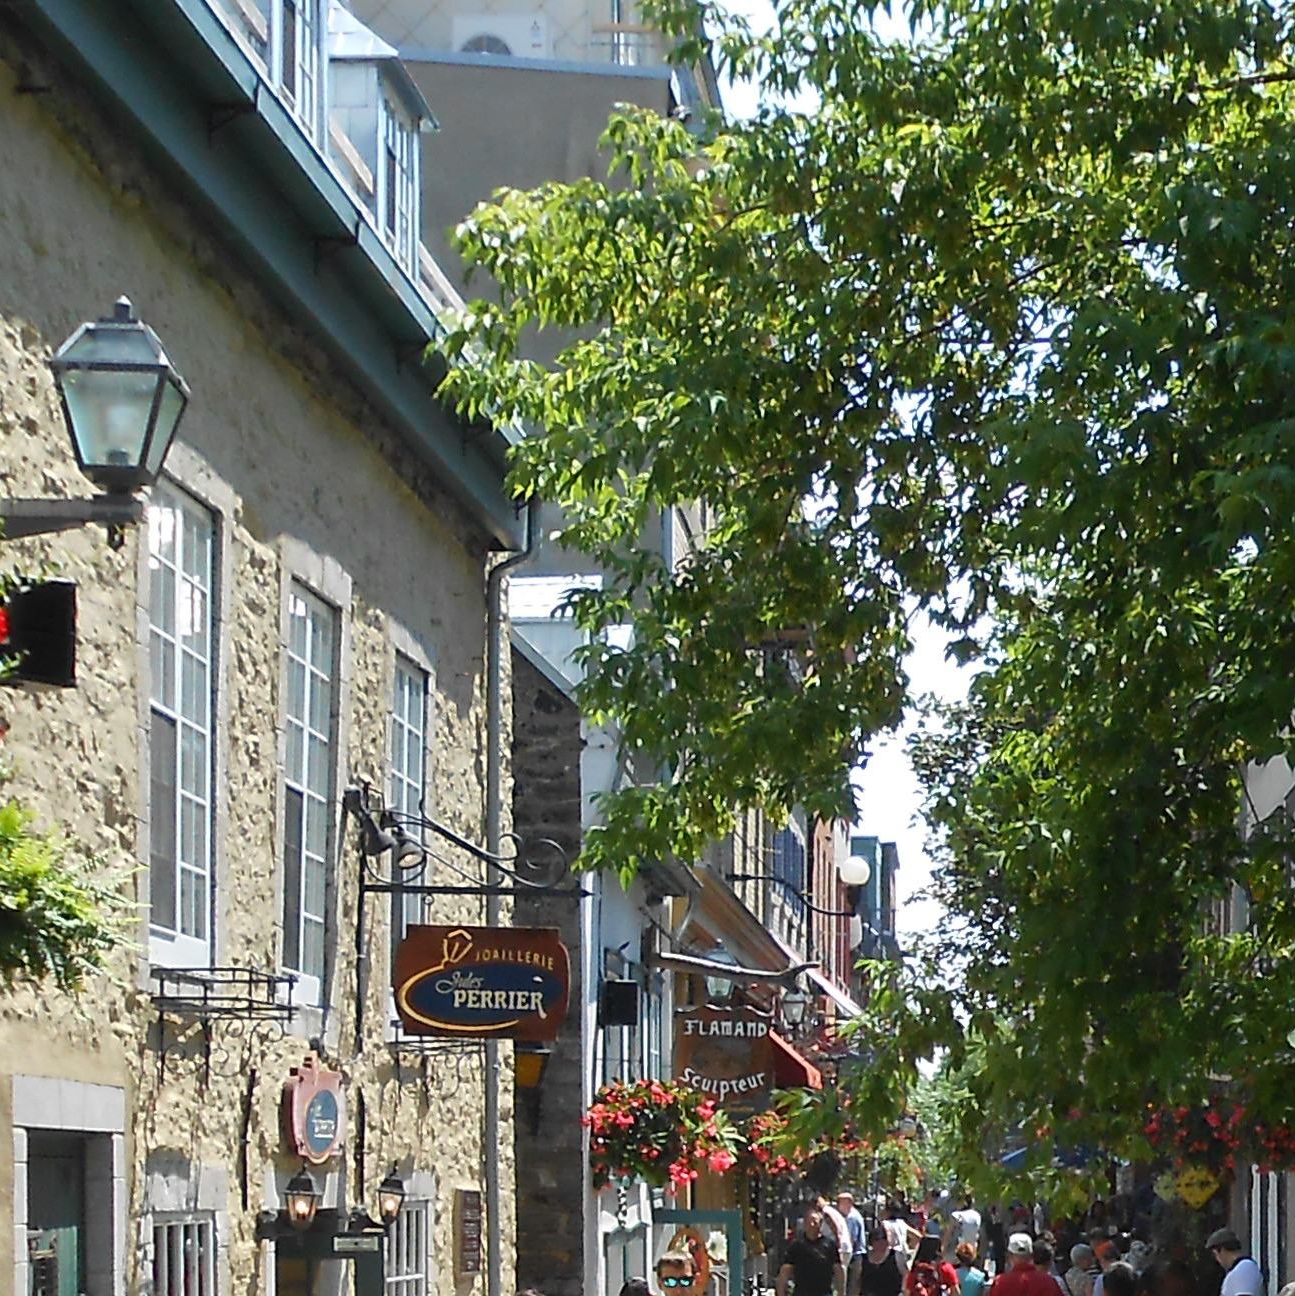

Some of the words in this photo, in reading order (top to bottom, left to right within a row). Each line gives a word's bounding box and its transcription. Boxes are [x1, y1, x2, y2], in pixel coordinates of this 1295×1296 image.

[476, 949, 554, 971] JOAILLERIE
[435, 971, 484, 994] Jules
[453, 989, 547, 1019] PERRIER
[683, 1019, 768, 1037] FLAMAND
[679, 1067, 766, 1102] Sculpteur
